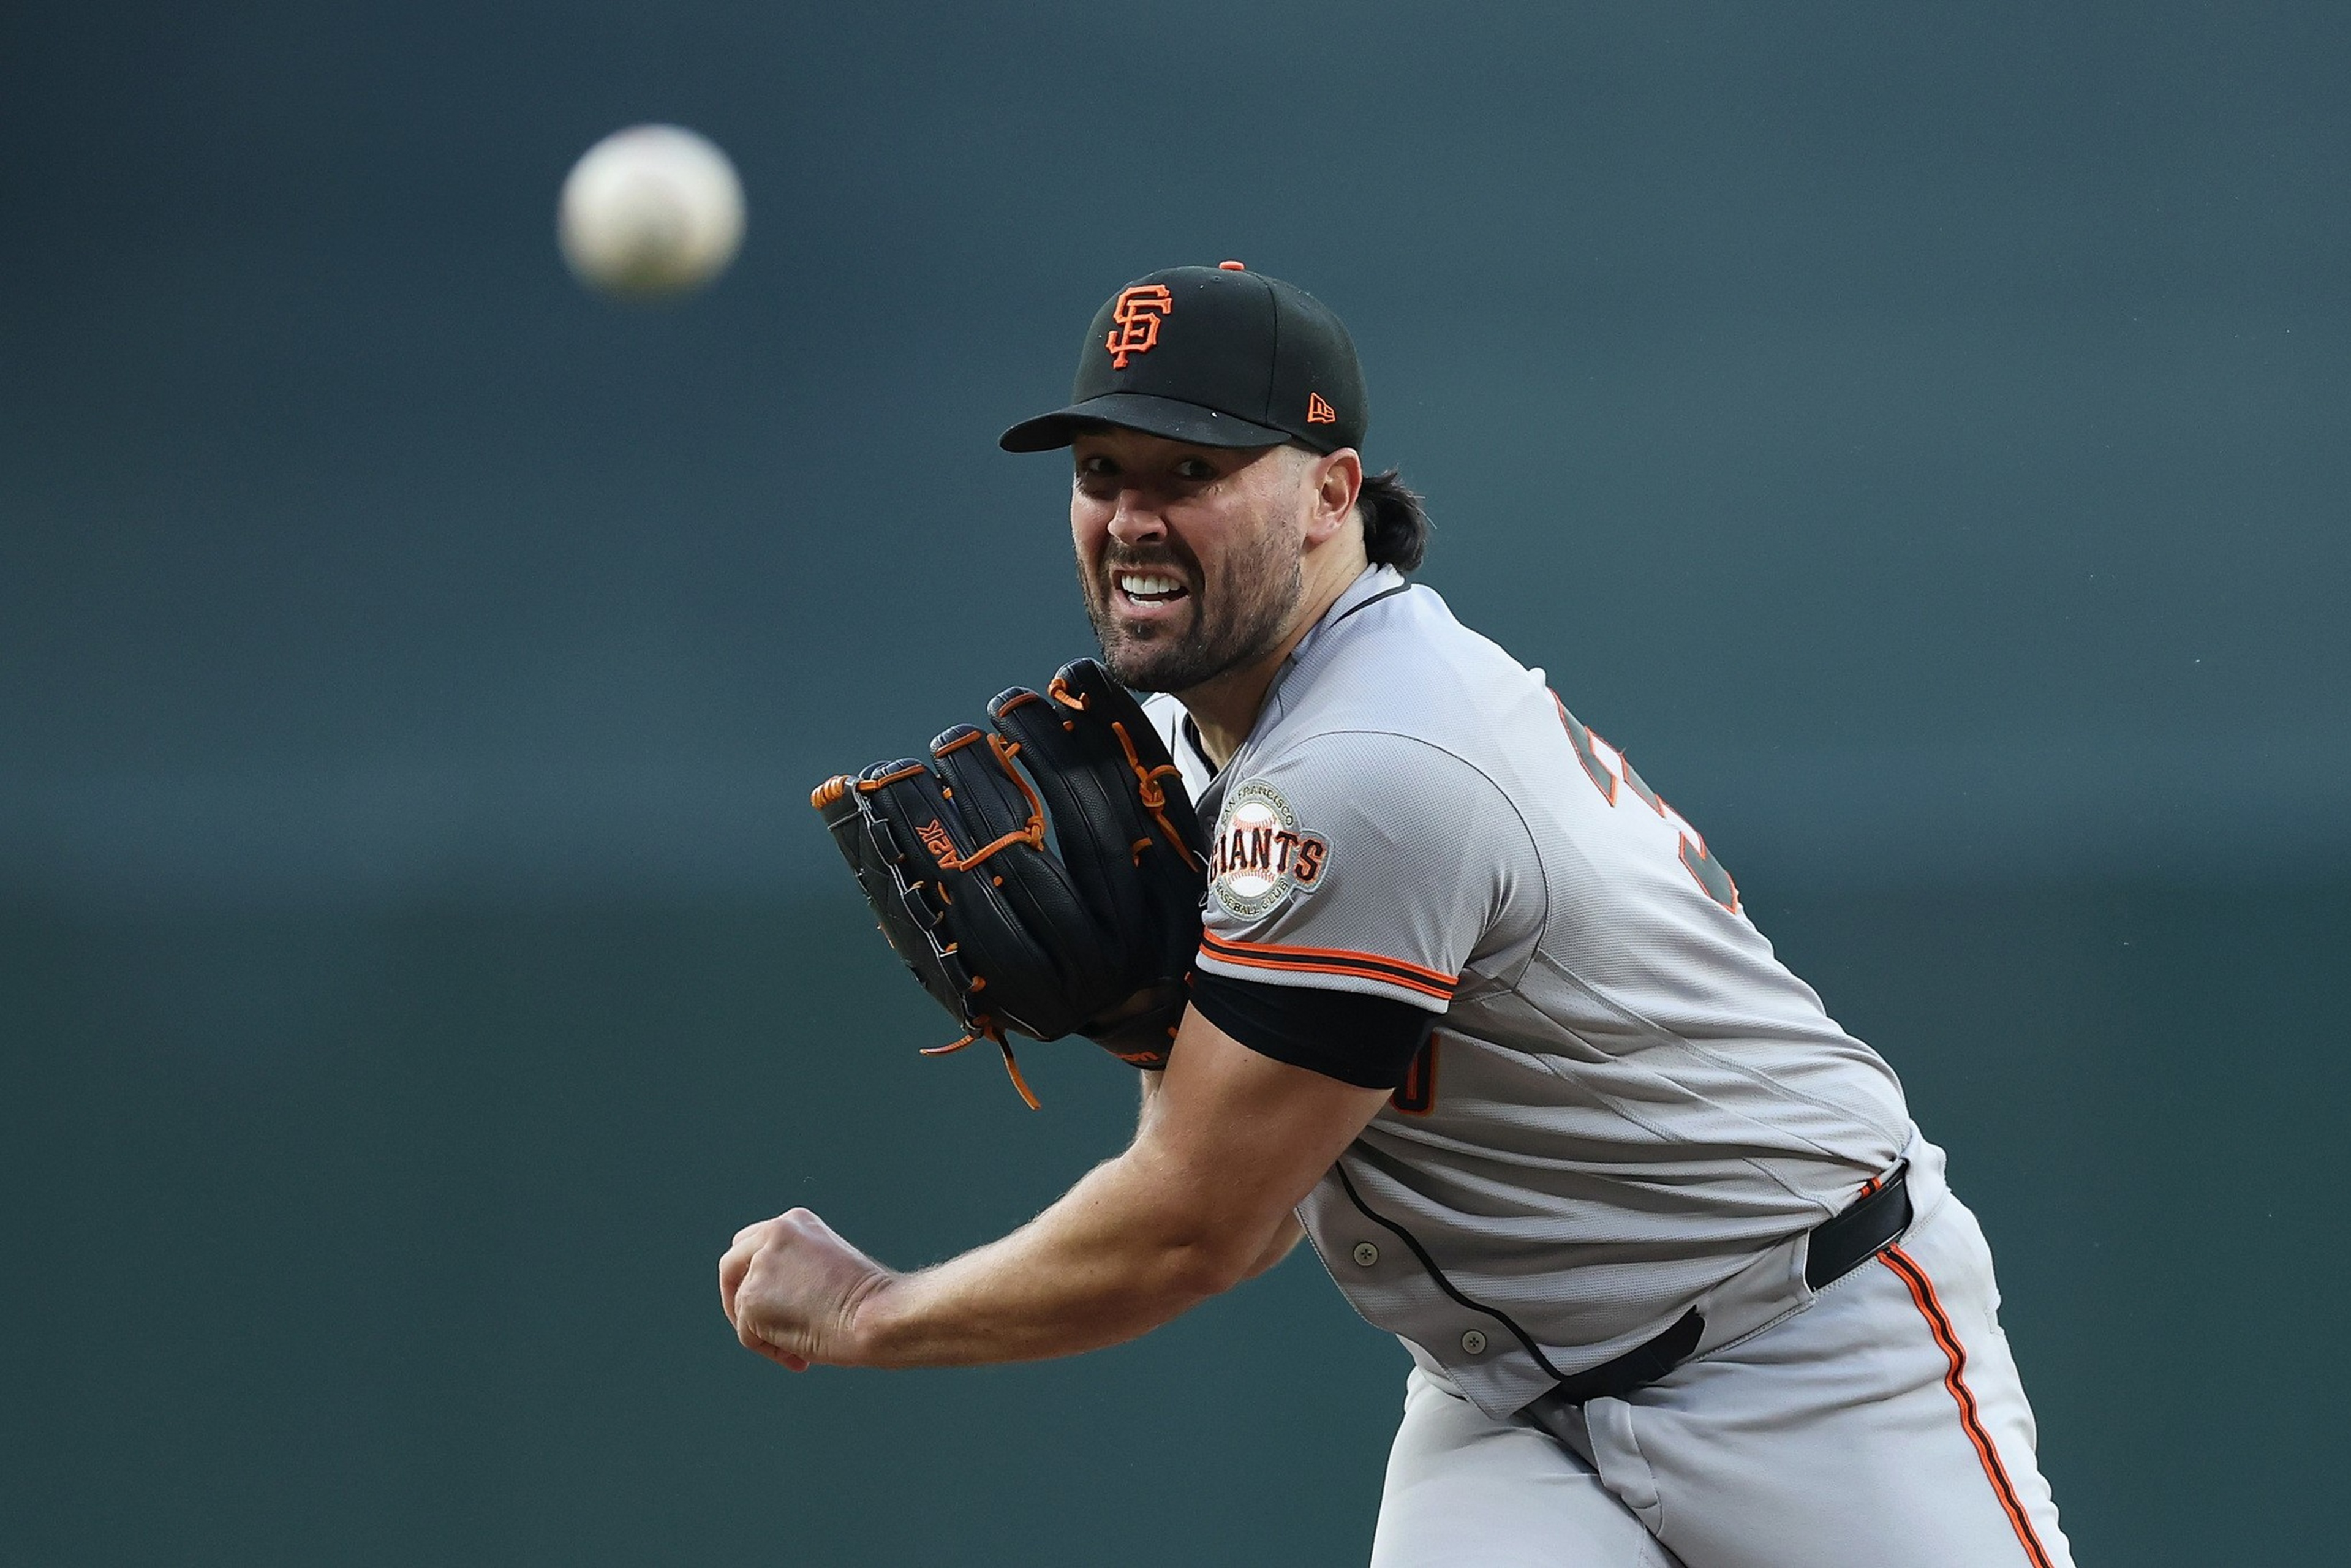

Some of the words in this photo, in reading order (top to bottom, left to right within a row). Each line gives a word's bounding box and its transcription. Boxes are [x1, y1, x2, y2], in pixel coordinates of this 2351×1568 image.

[1104, 284, 1173, 370] SF
[1237, 785, 1294, 826] FRANCISCO
[915, 818, 962, 869] A2K
[1215, 881, 1259, 914] BASEBALL
[1261, 880, 1289, 910] CLUB
